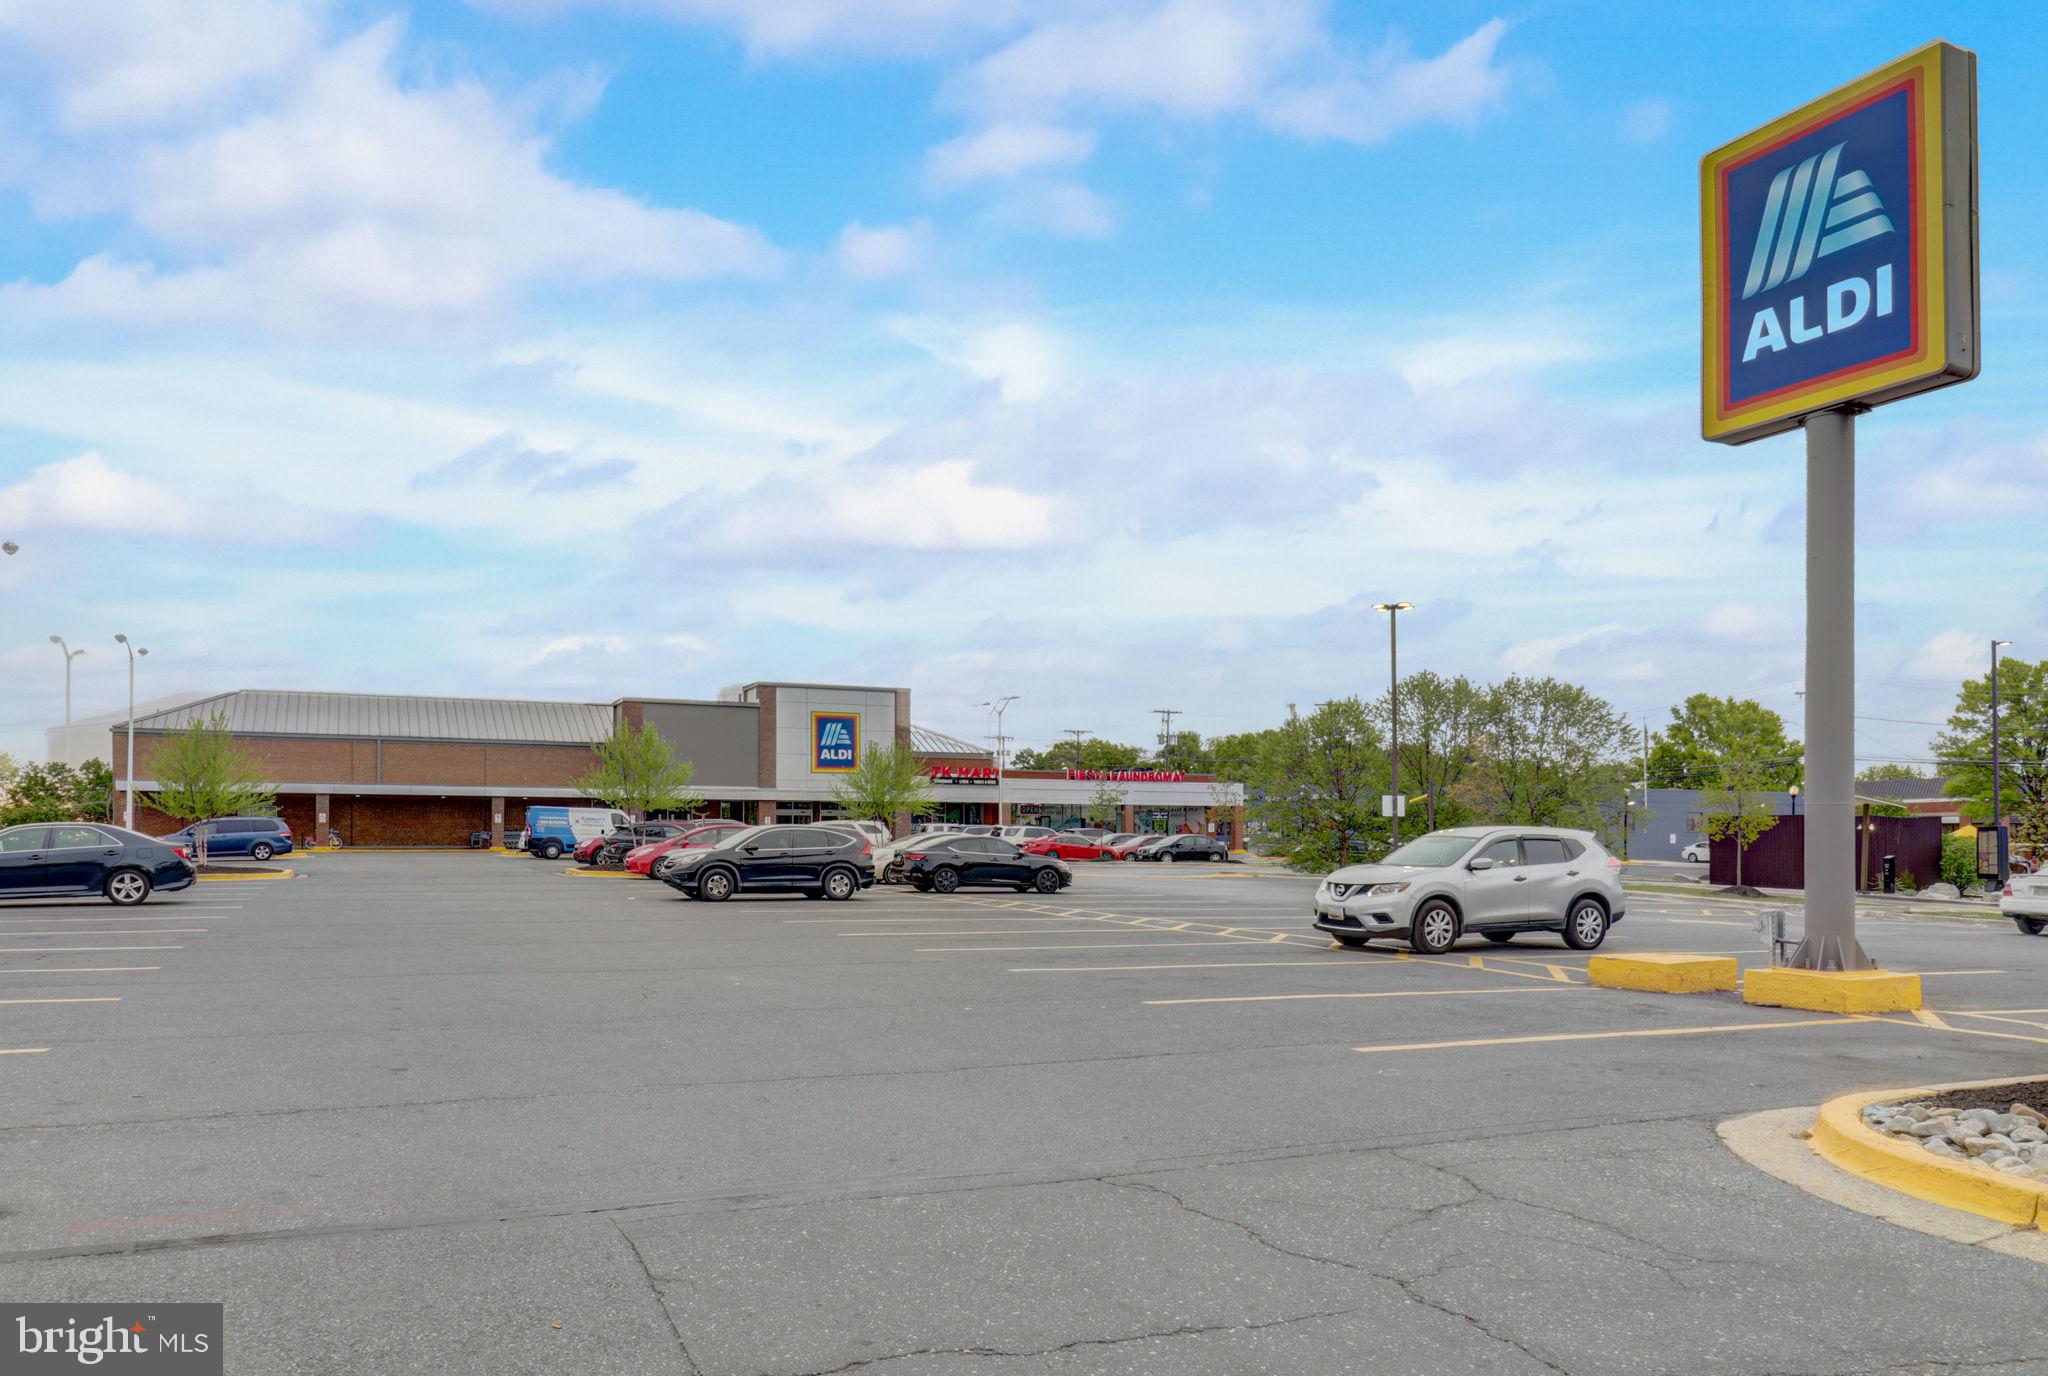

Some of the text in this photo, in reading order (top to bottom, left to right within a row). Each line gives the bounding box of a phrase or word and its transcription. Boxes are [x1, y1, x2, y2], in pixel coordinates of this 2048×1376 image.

[1742, 263, 1892, 363] ALDI
[820, 749, 852, 760] ALDI
[957, 767, 999, 779] MART
[1110, 769, 1185, 782] LAUNDROMAT
